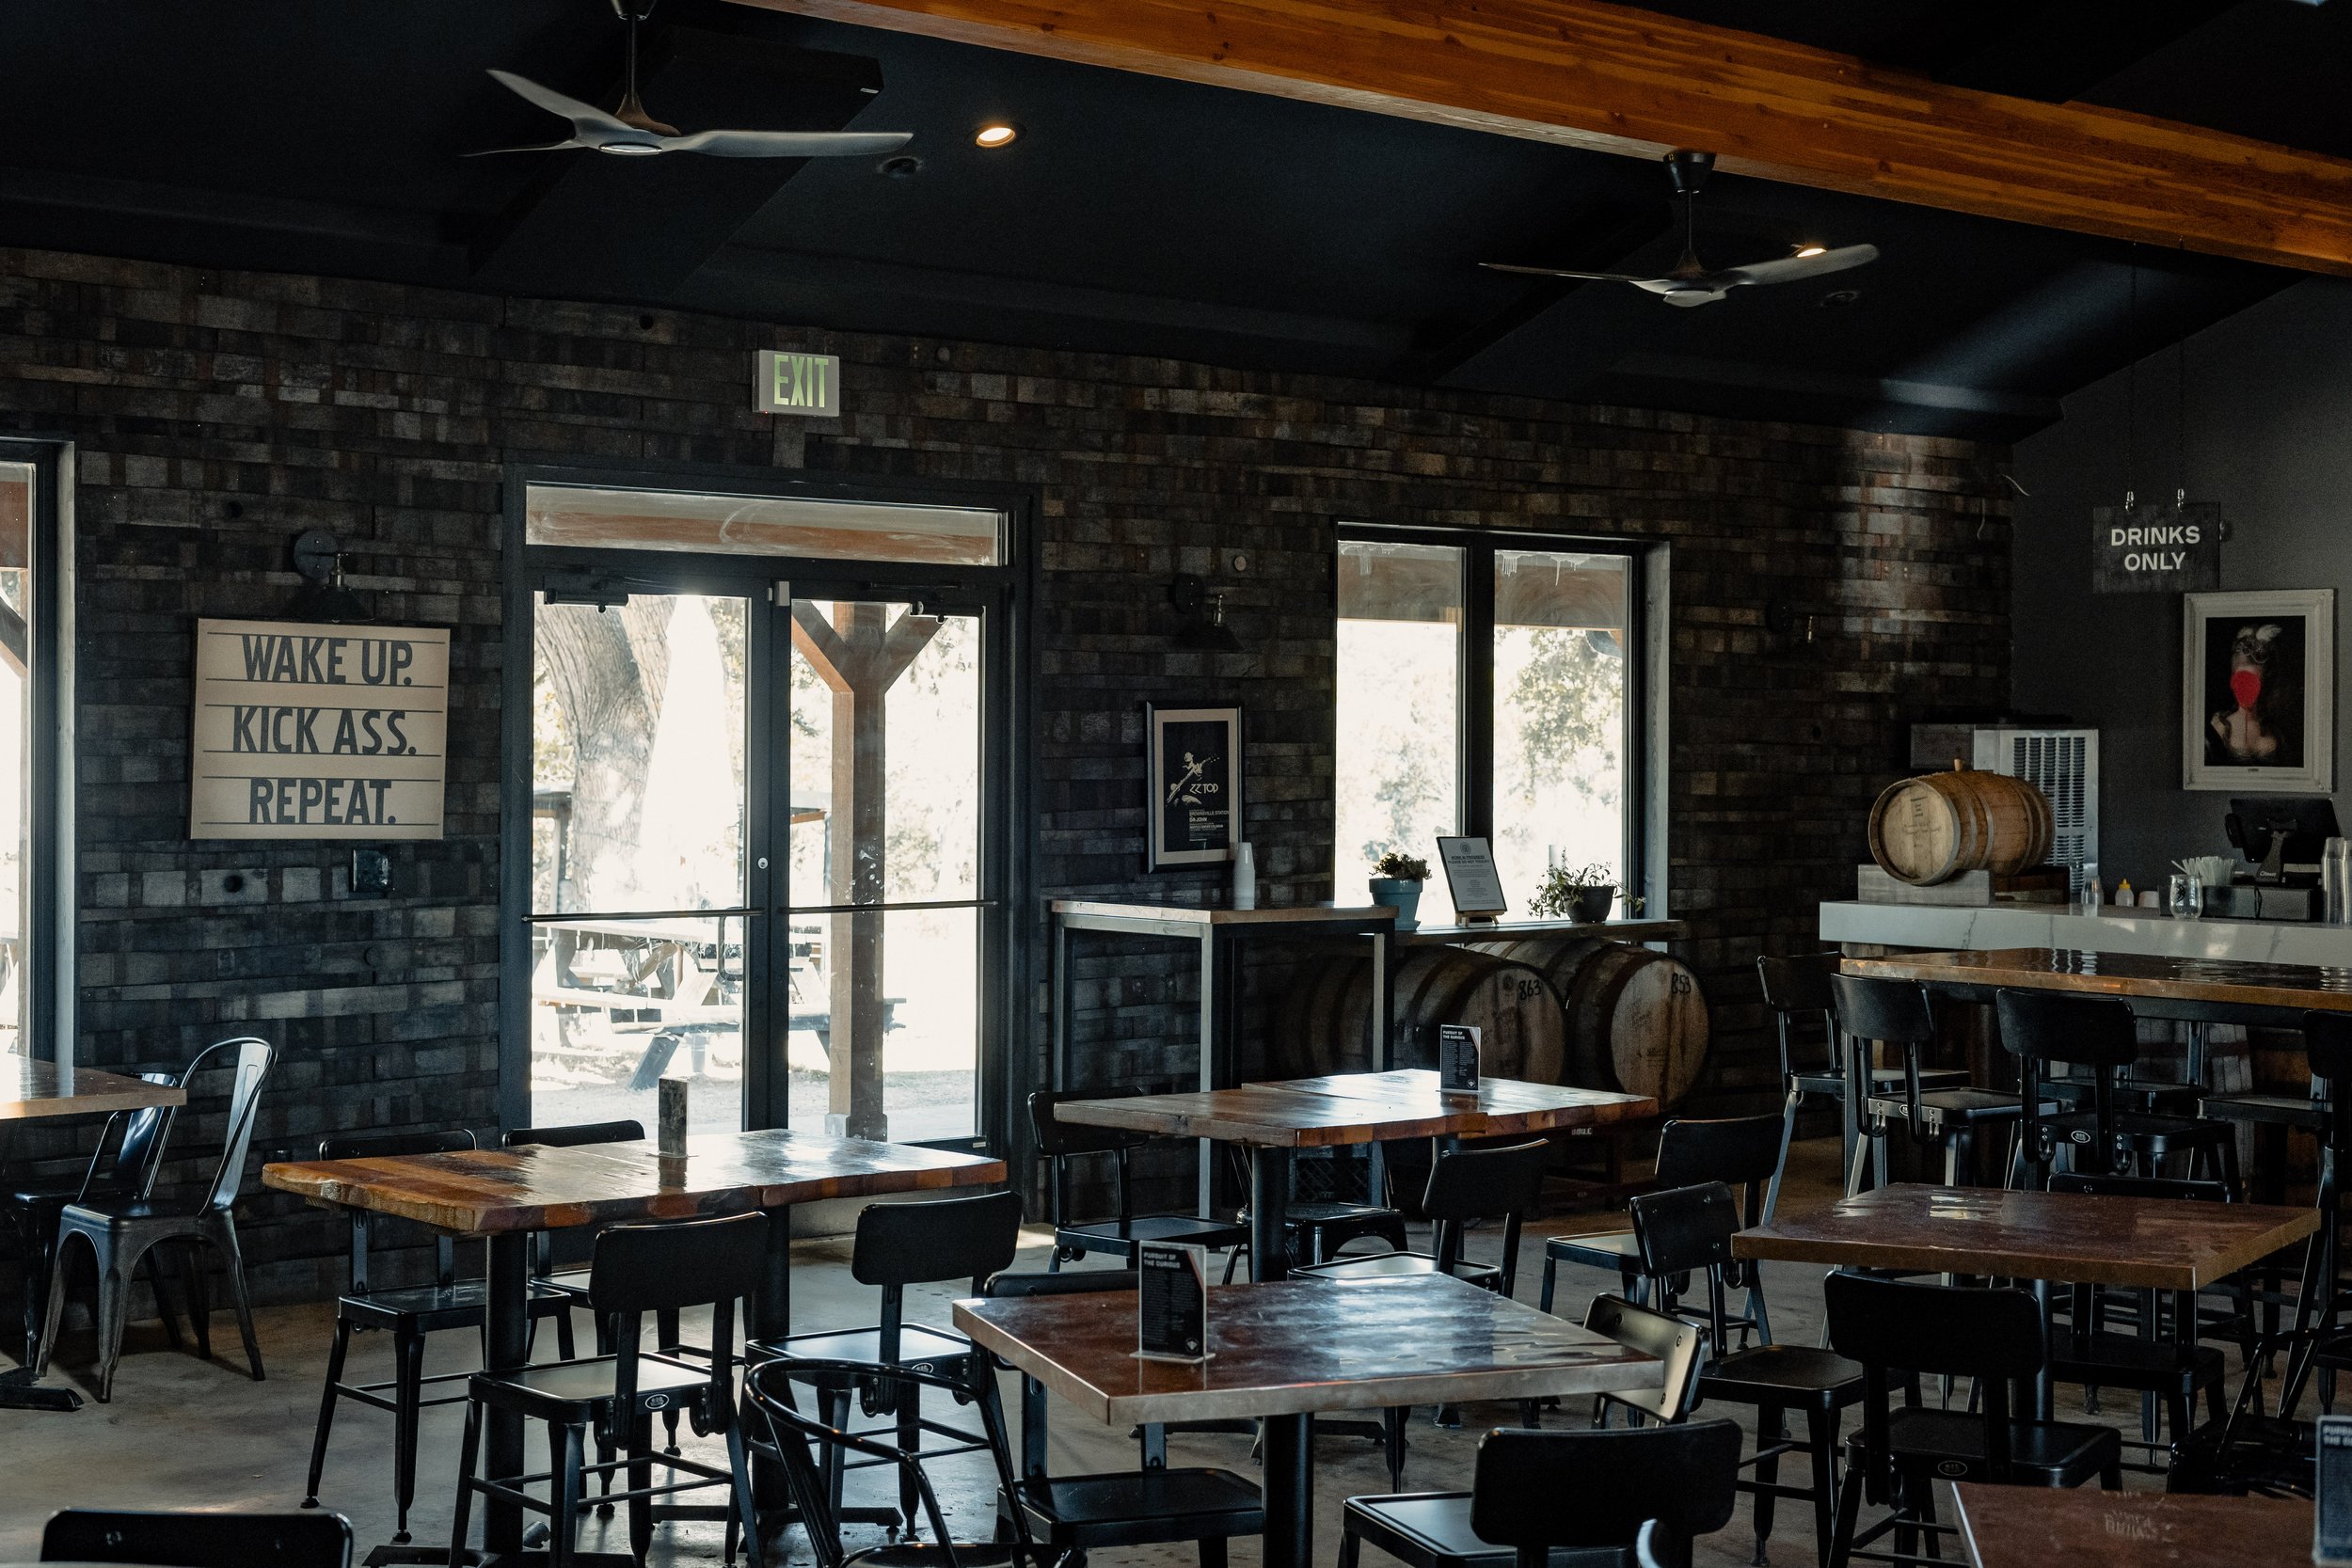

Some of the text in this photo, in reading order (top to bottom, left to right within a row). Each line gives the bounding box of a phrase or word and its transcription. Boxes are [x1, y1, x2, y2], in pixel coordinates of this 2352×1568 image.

[774, 354, 829, 407] EXIT
[2111, 525, 2201, 546] DRINKS
[2124, 551, 2186, 571] ONLY
[242, 634, 413, 687] WAKE UP.
[232, 705, 417, 755] KICK ASS.
[1189, 783, 1219, 794] ZZ TOP
[248, 778, 397, 825] REPEAT.
[1518, 978, 1542, 1001] 863
[1671, 973, 1692, 994] 853
